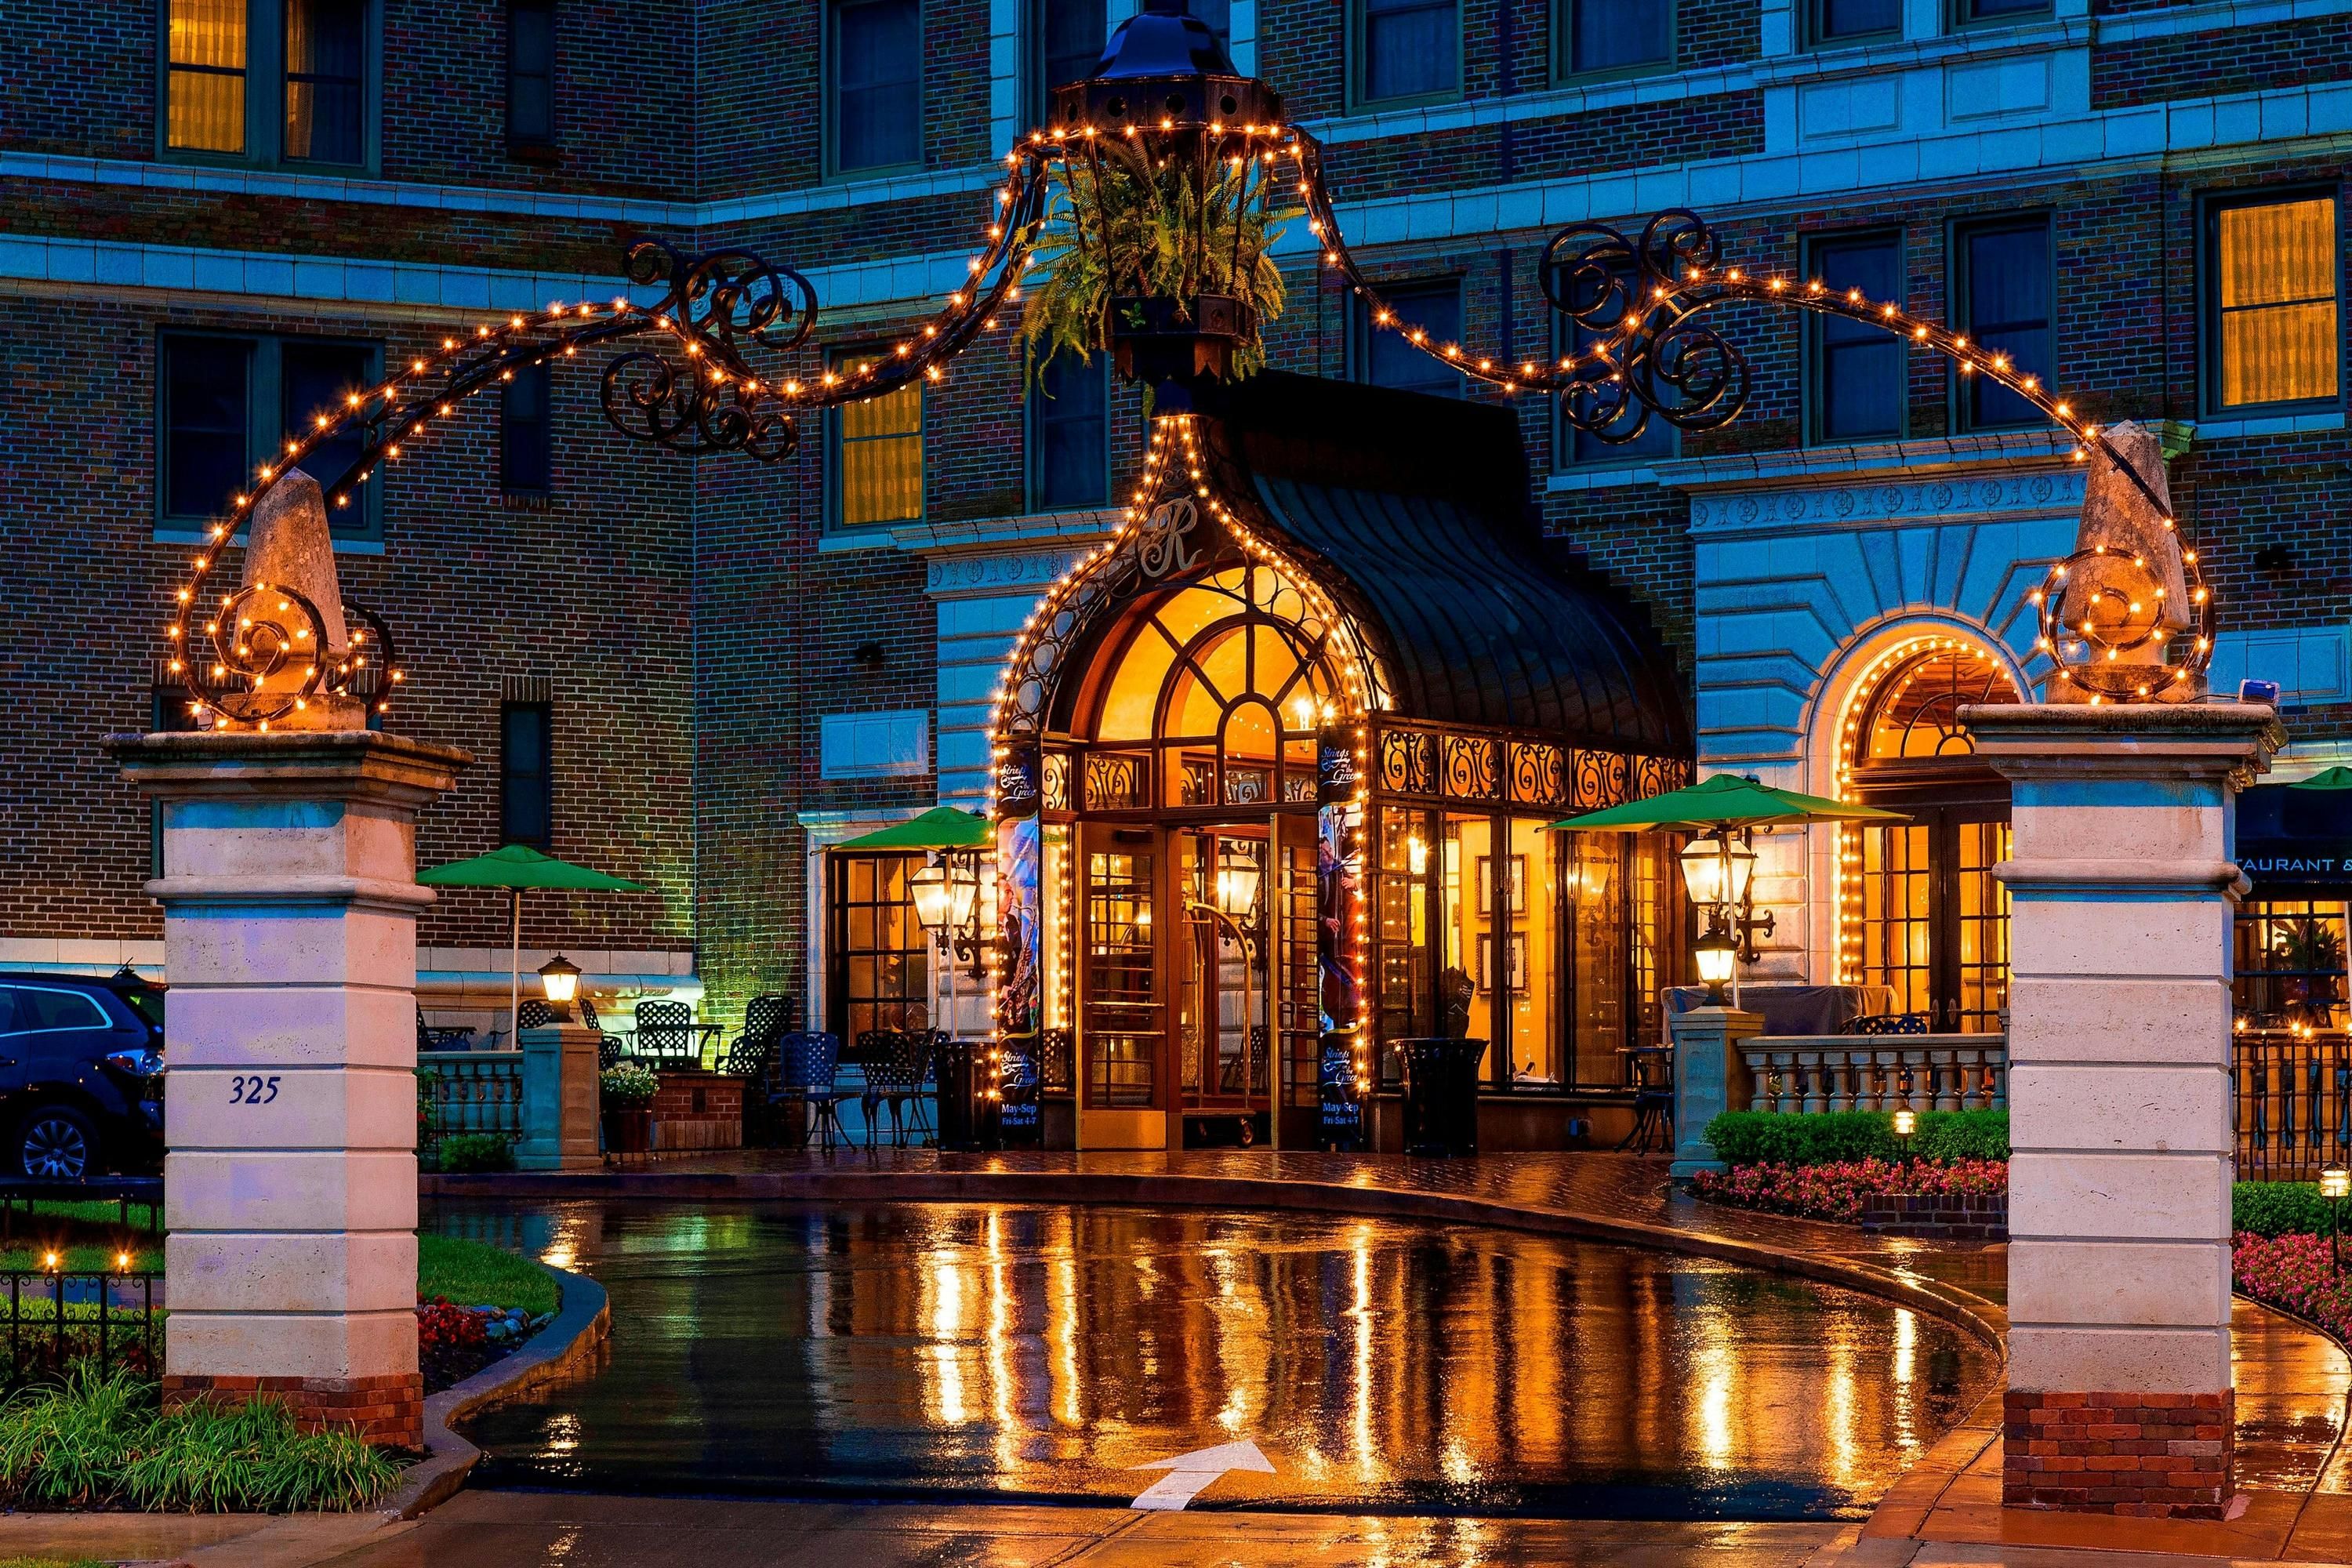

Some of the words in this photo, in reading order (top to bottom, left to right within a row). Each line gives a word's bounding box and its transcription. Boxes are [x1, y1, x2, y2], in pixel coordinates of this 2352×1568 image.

[1322, 746, 1348, 760] Strings
[1334, 768, 1358, 786] Gree
[2343, 858, 2352, 871] &
[1002, 1051, 1029, 1063] Strings
[1326, 1047, 1349, 1060] Strings
[1014, 1073, 1037, 1090] Green
[1336, 1071, 1359, 1087] Green
[229, 1076, 281, 1104] 325
